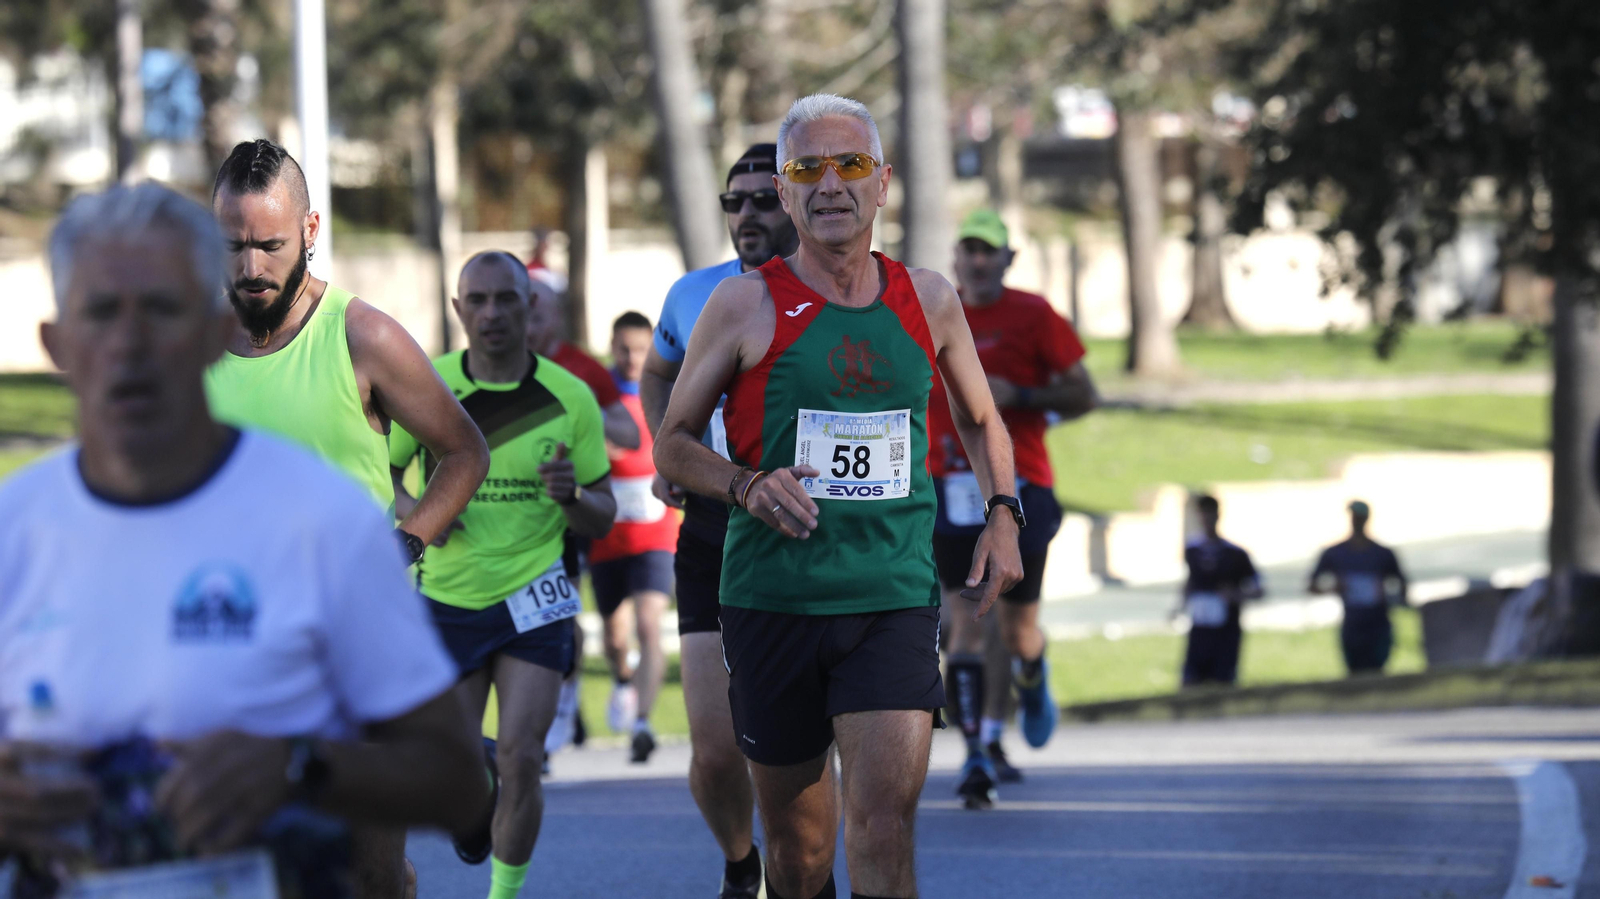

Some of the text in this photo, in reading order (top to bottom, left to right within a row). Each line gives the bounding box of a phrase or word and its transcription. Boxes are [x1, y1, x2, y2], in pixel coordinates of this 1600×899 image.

[835, 423, 883, 434] MARATÓN
[831, 445, 871, 479] 58
[893, 469, 900, 477] M
[826, 485, 884, 497] EVOS
[526, 575, 571, 608] 190
